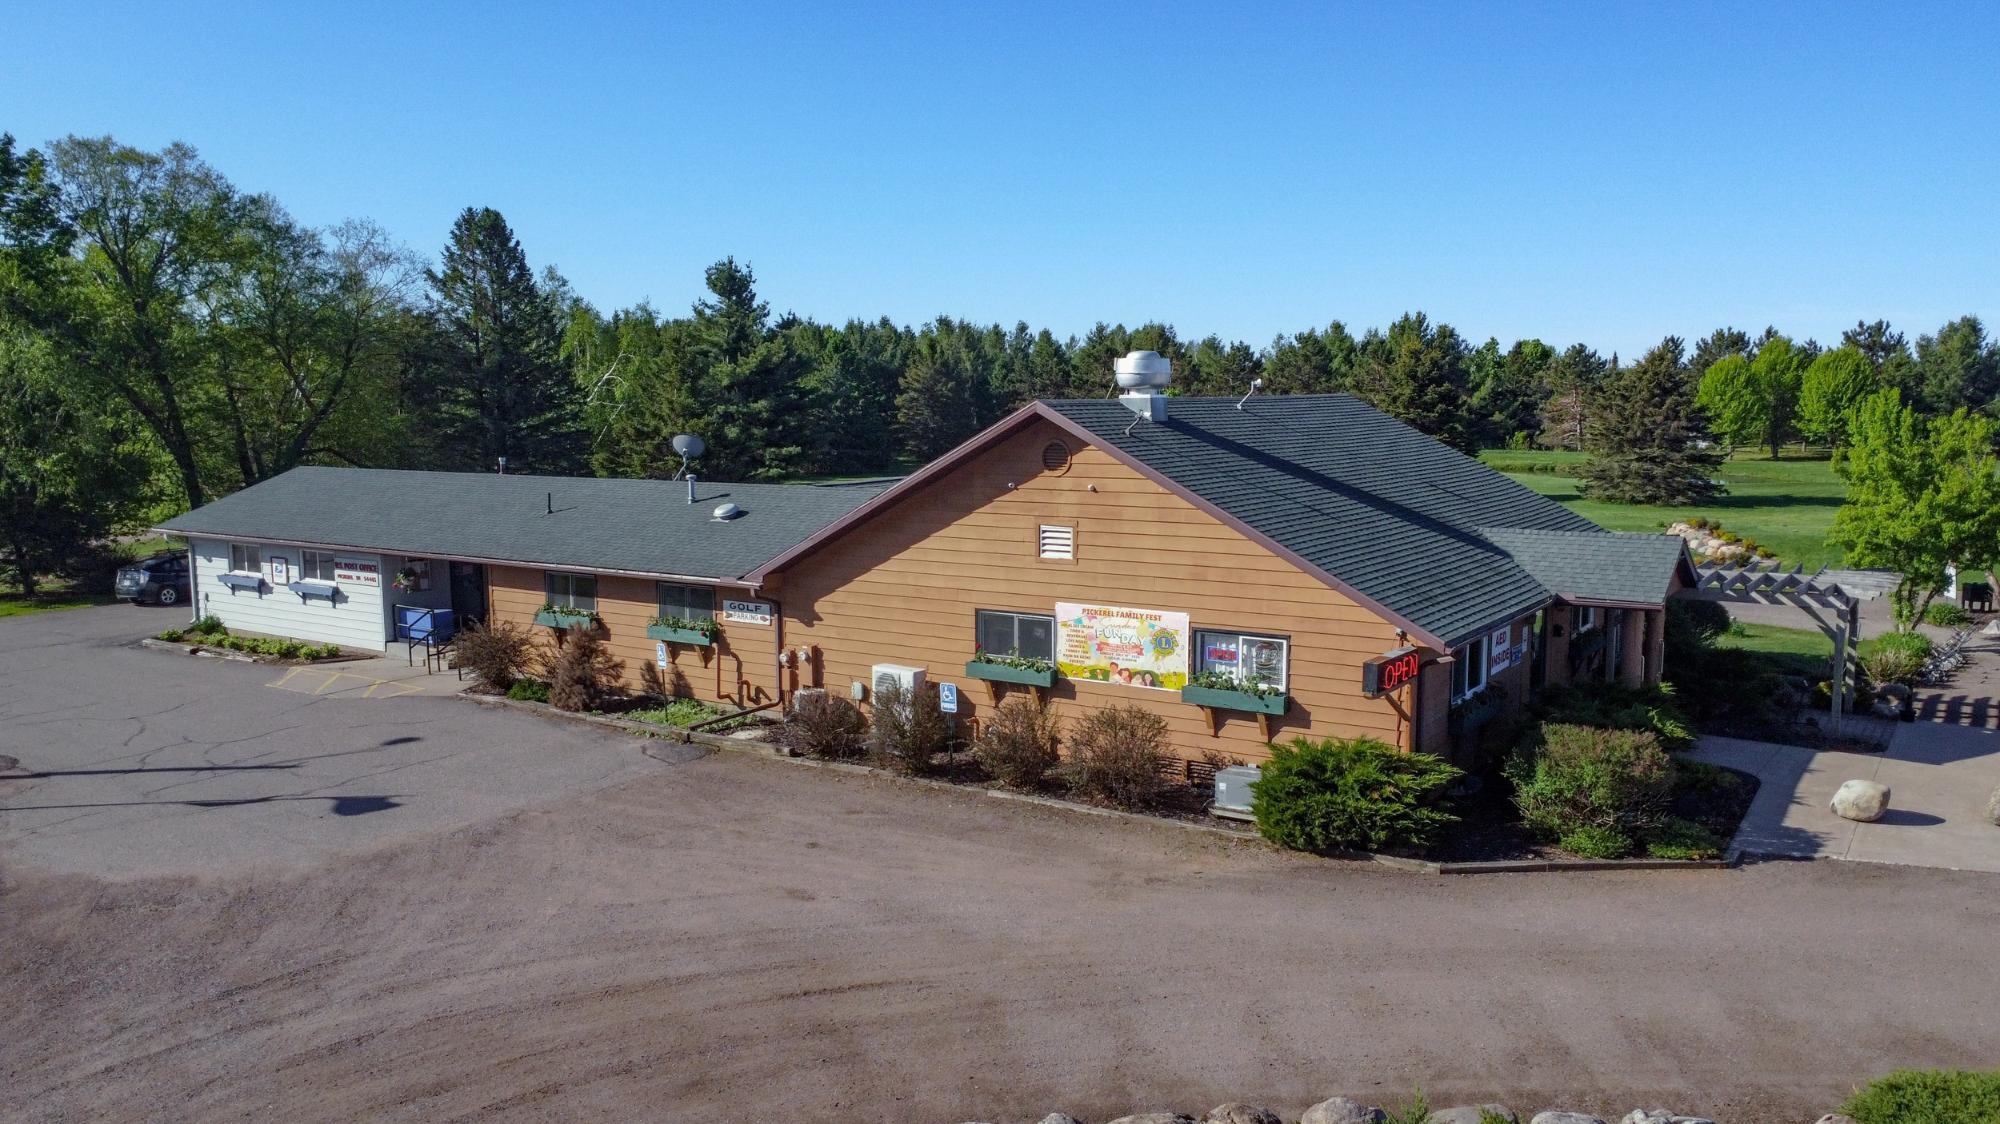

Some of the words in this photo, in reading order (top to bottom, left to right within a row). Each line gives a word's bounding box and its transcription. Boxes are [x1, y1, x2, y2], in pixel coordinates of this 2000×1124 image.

[344, 562, 358, 570] POST
[359, 563, 377, 572] OFFICE
[729, 602, 762, 611] GOLF
[733, 612, 759, 620] PARKING
[1081, 608, 1115, 617] PICKEREL
[1116, 611, 1144, 620] FAMILY
[1145, 613, 1162, 621] FEST
[1095, 627, 1120, 638] FUN
[1120, 633, 1145, 645] DAY
[1212, 649, 1236, 661] OPEN
[1491, 647, 1511, 668] INSIDE
[1384, 653, 1418, 688] OPEN
